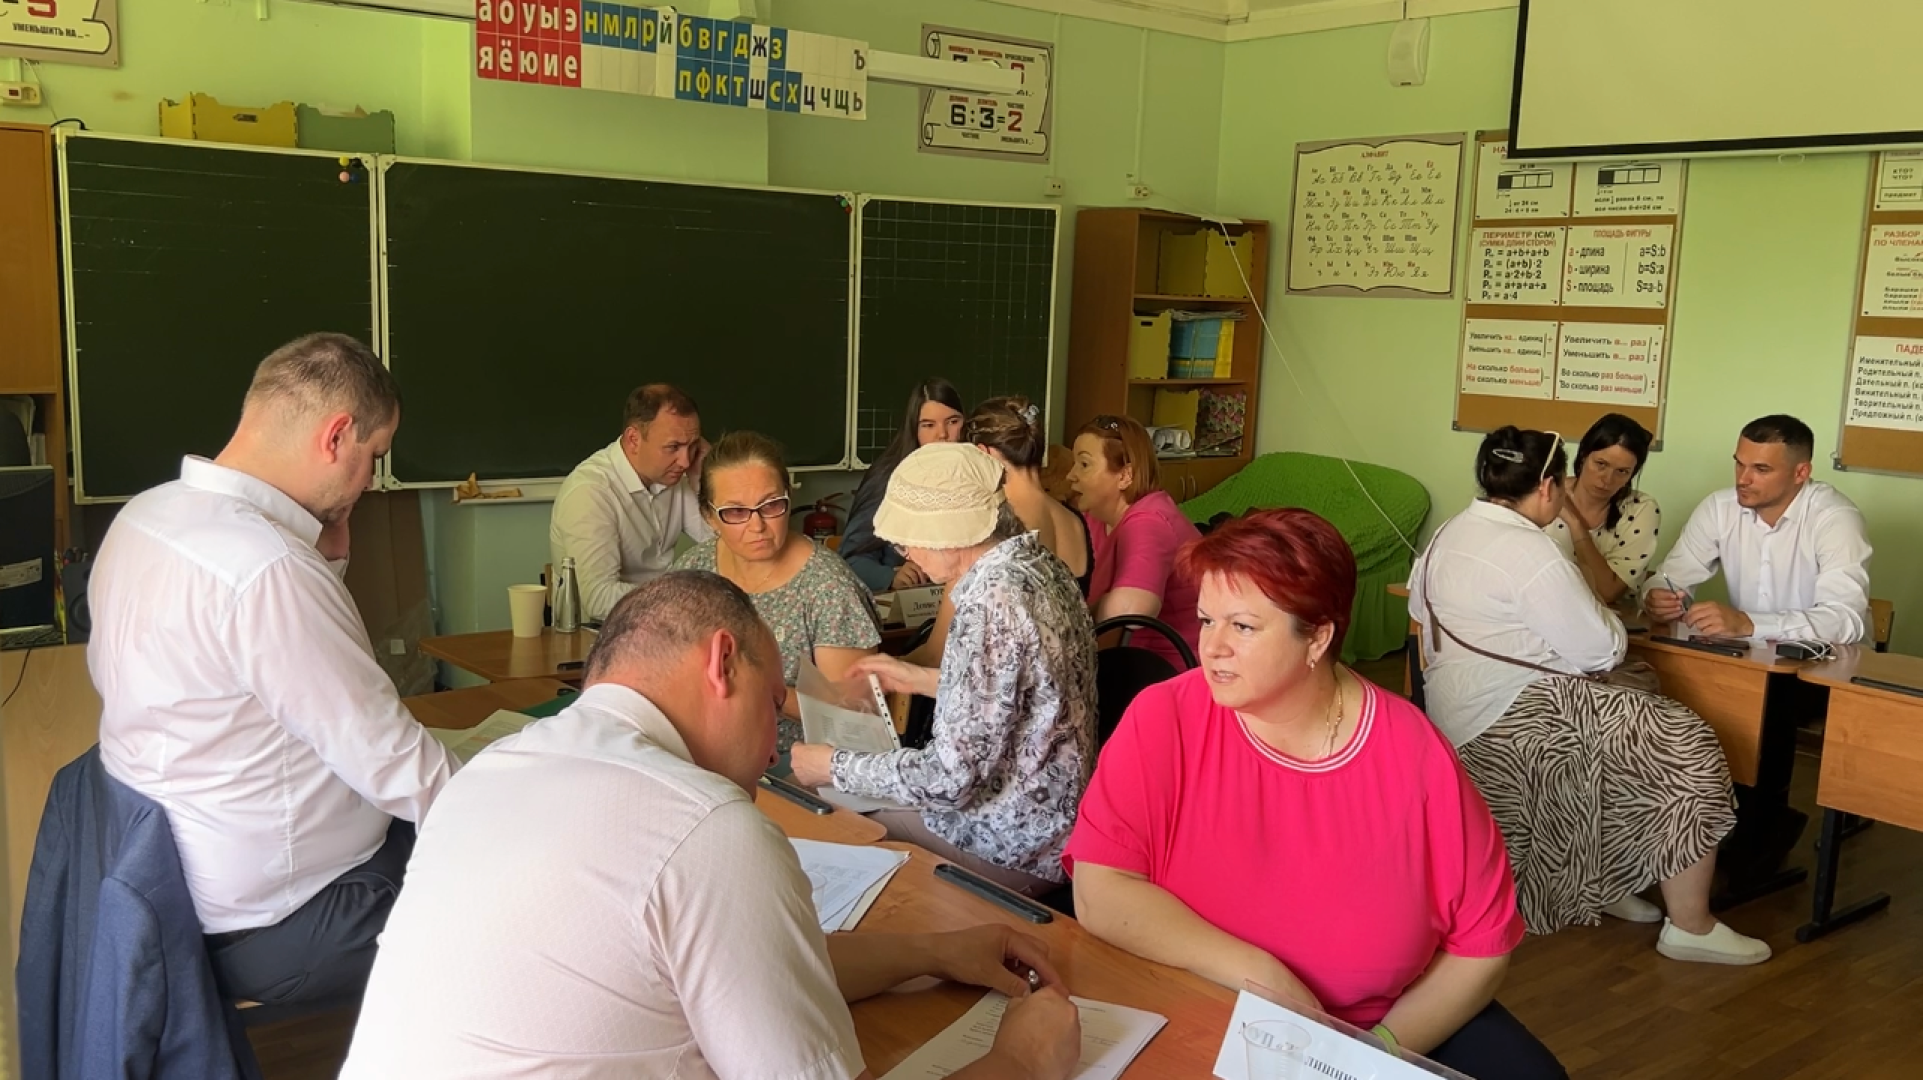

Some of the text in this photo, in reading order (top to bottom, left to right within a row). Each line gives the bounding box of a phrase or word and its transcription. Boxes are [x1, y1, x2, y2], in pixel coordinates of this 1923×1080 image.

[13, 23, 63, 36] УМЕНЬШИТЬ
[1483, 231, 1555, 239] ПЕРИМЕТР (СМ)
[1593, 229, 1652, 238] ПЛОЩАДЬ ФИГУРЫ
[1884, 230, 1920, 238] РАЗБОР
[1580, 246, 1605, 258] длина
[1579, 264, 1610, 277] ширина
[1578, 282, 1614, 294] площадь
[1470, 332, 1502, 341] Увеличить
[1518, 334, 1543, 343] единиц
[1564, 334, 1612, 345] Увеличить
[1630, 339, 1646, 348] раз
[1517, 348, 1541, 356] единиц
[1563, 348, 1610, 359] Уменьшить
[1628, 354, 1645, 362] раз
[1860, 355, 1920, 367] Именительный
[1477, 364, 1508, 372] сколько
[1510, 364, 1540, 373] больше
[1561, 367, 1643, 381] Во сколько раз больше
[1858, 366, 1913, 377] Родительный
[1477, 375, 1507, 384] сколько
[1509, 378, 1540, 386] меньше
[1856, 377, 1902, 387] Дательный
[1561, 381, 1642, 394] Во сколько раз меньше
[1855, 387, 1911, 398] Винительный
[1854, 398, 1913, 410] Творительный
[1852, 408, 1905, 419] Предложный
